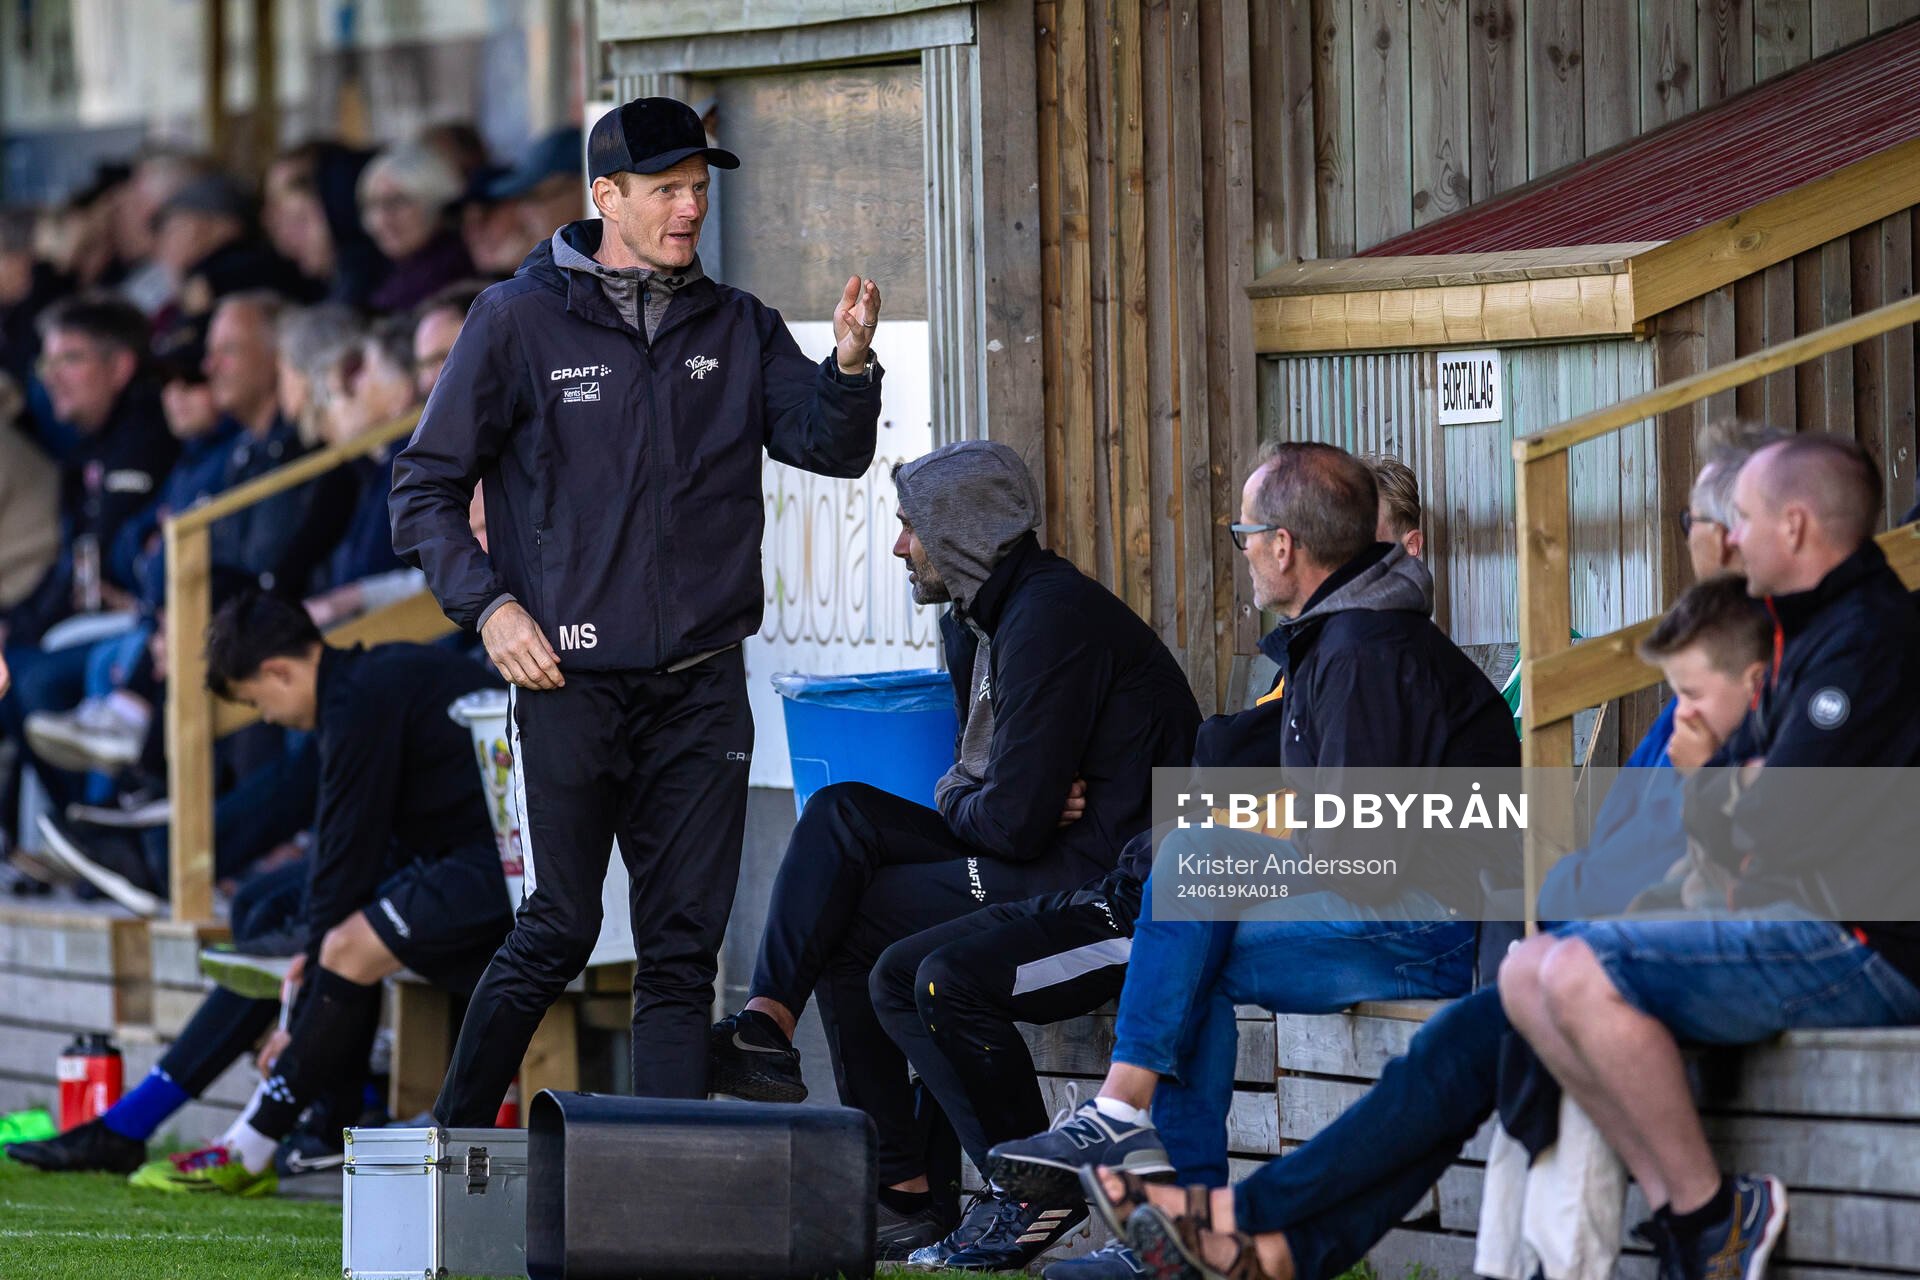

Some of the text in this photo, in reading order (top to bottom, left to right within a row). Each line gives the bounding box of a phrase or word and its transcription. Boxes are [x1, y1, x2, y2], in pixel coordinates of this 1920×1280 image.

[551, 365, 599, 381] CRAFT
[1442, 360, 1493, 411] BORTALAG
[559, 623, 598, 650] MS
